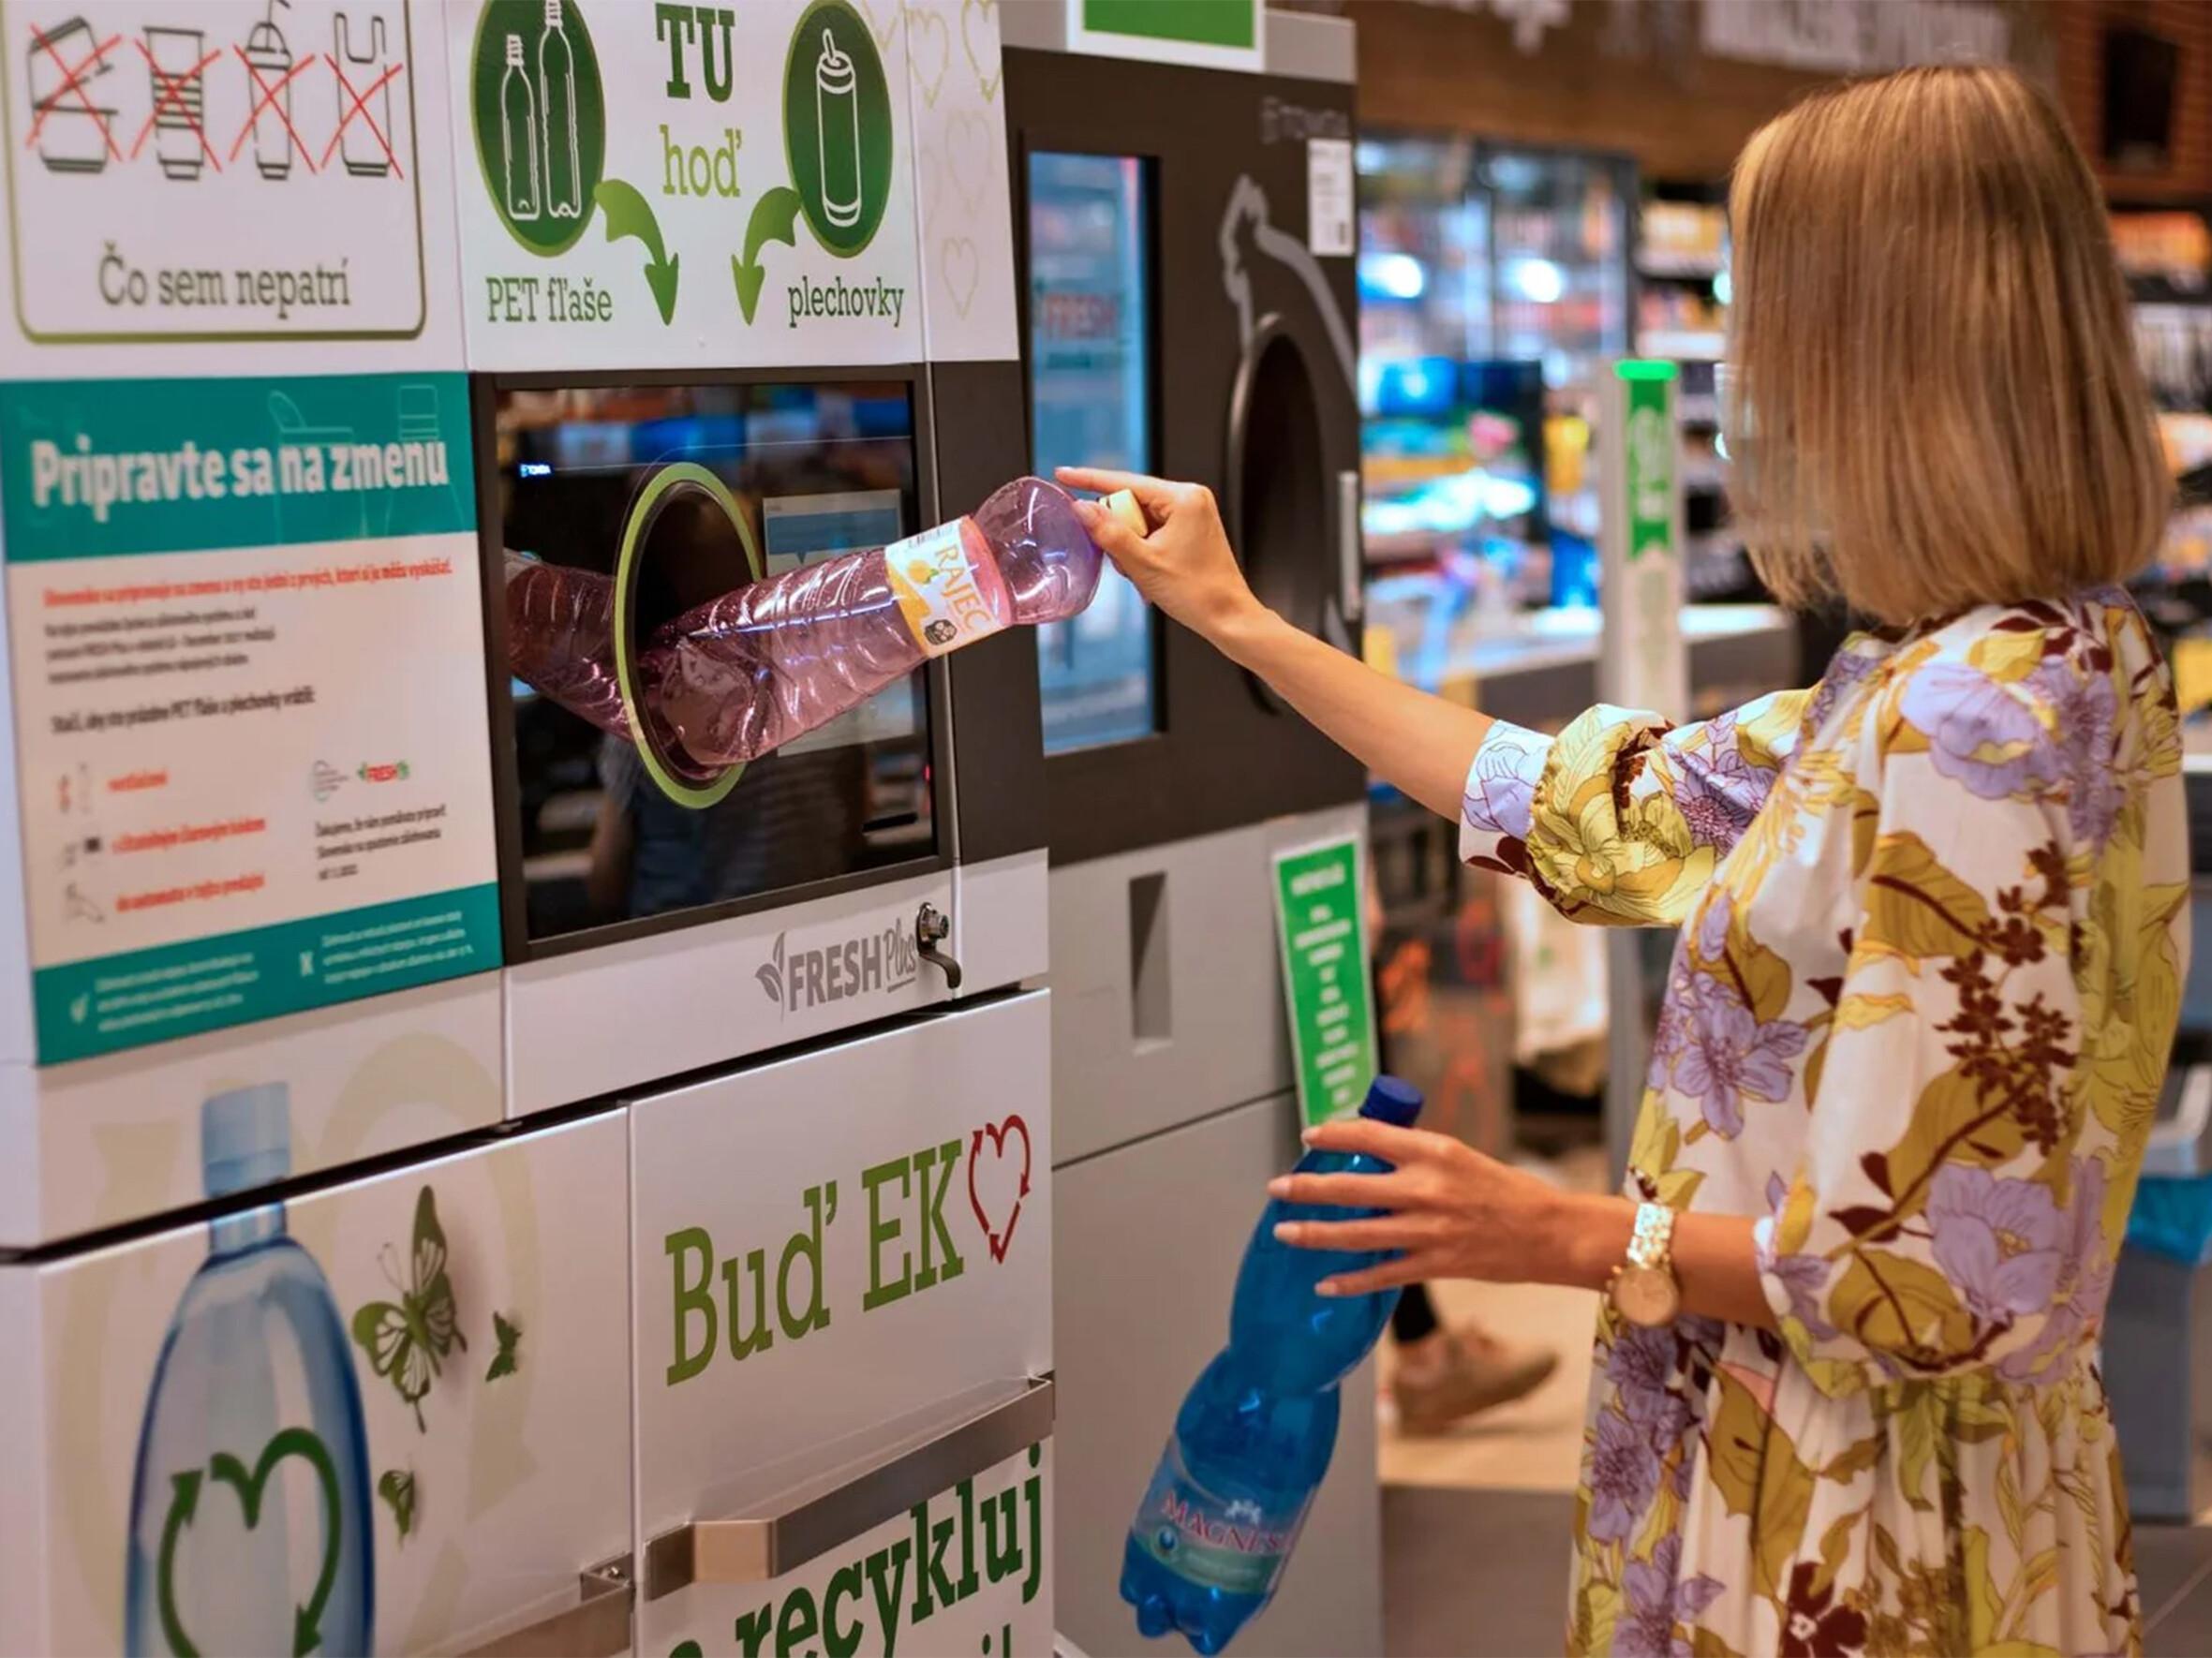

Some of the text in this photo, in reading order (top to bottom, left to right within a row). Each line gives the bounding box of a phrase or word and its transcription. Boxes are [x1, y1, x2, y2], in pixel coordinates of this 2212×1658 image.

[658, 4, 735, 102] TU
[660, 126, 740, 197] hoď
[99, 242, 350, 318] Čo sem nepatrí
[487, 277, 612, 323] PET fľaše
[789, 275, 903, 328] plechovky
[31, 434, 449, 522] Pripravte sa na zmenu
[934, 542, 991, 631] RAJEC
[789, 935, 883, 1012] FRESH
[665, 1180, 837, 1386] Buď
[735, 1442, 1042, 1658] recykluj
